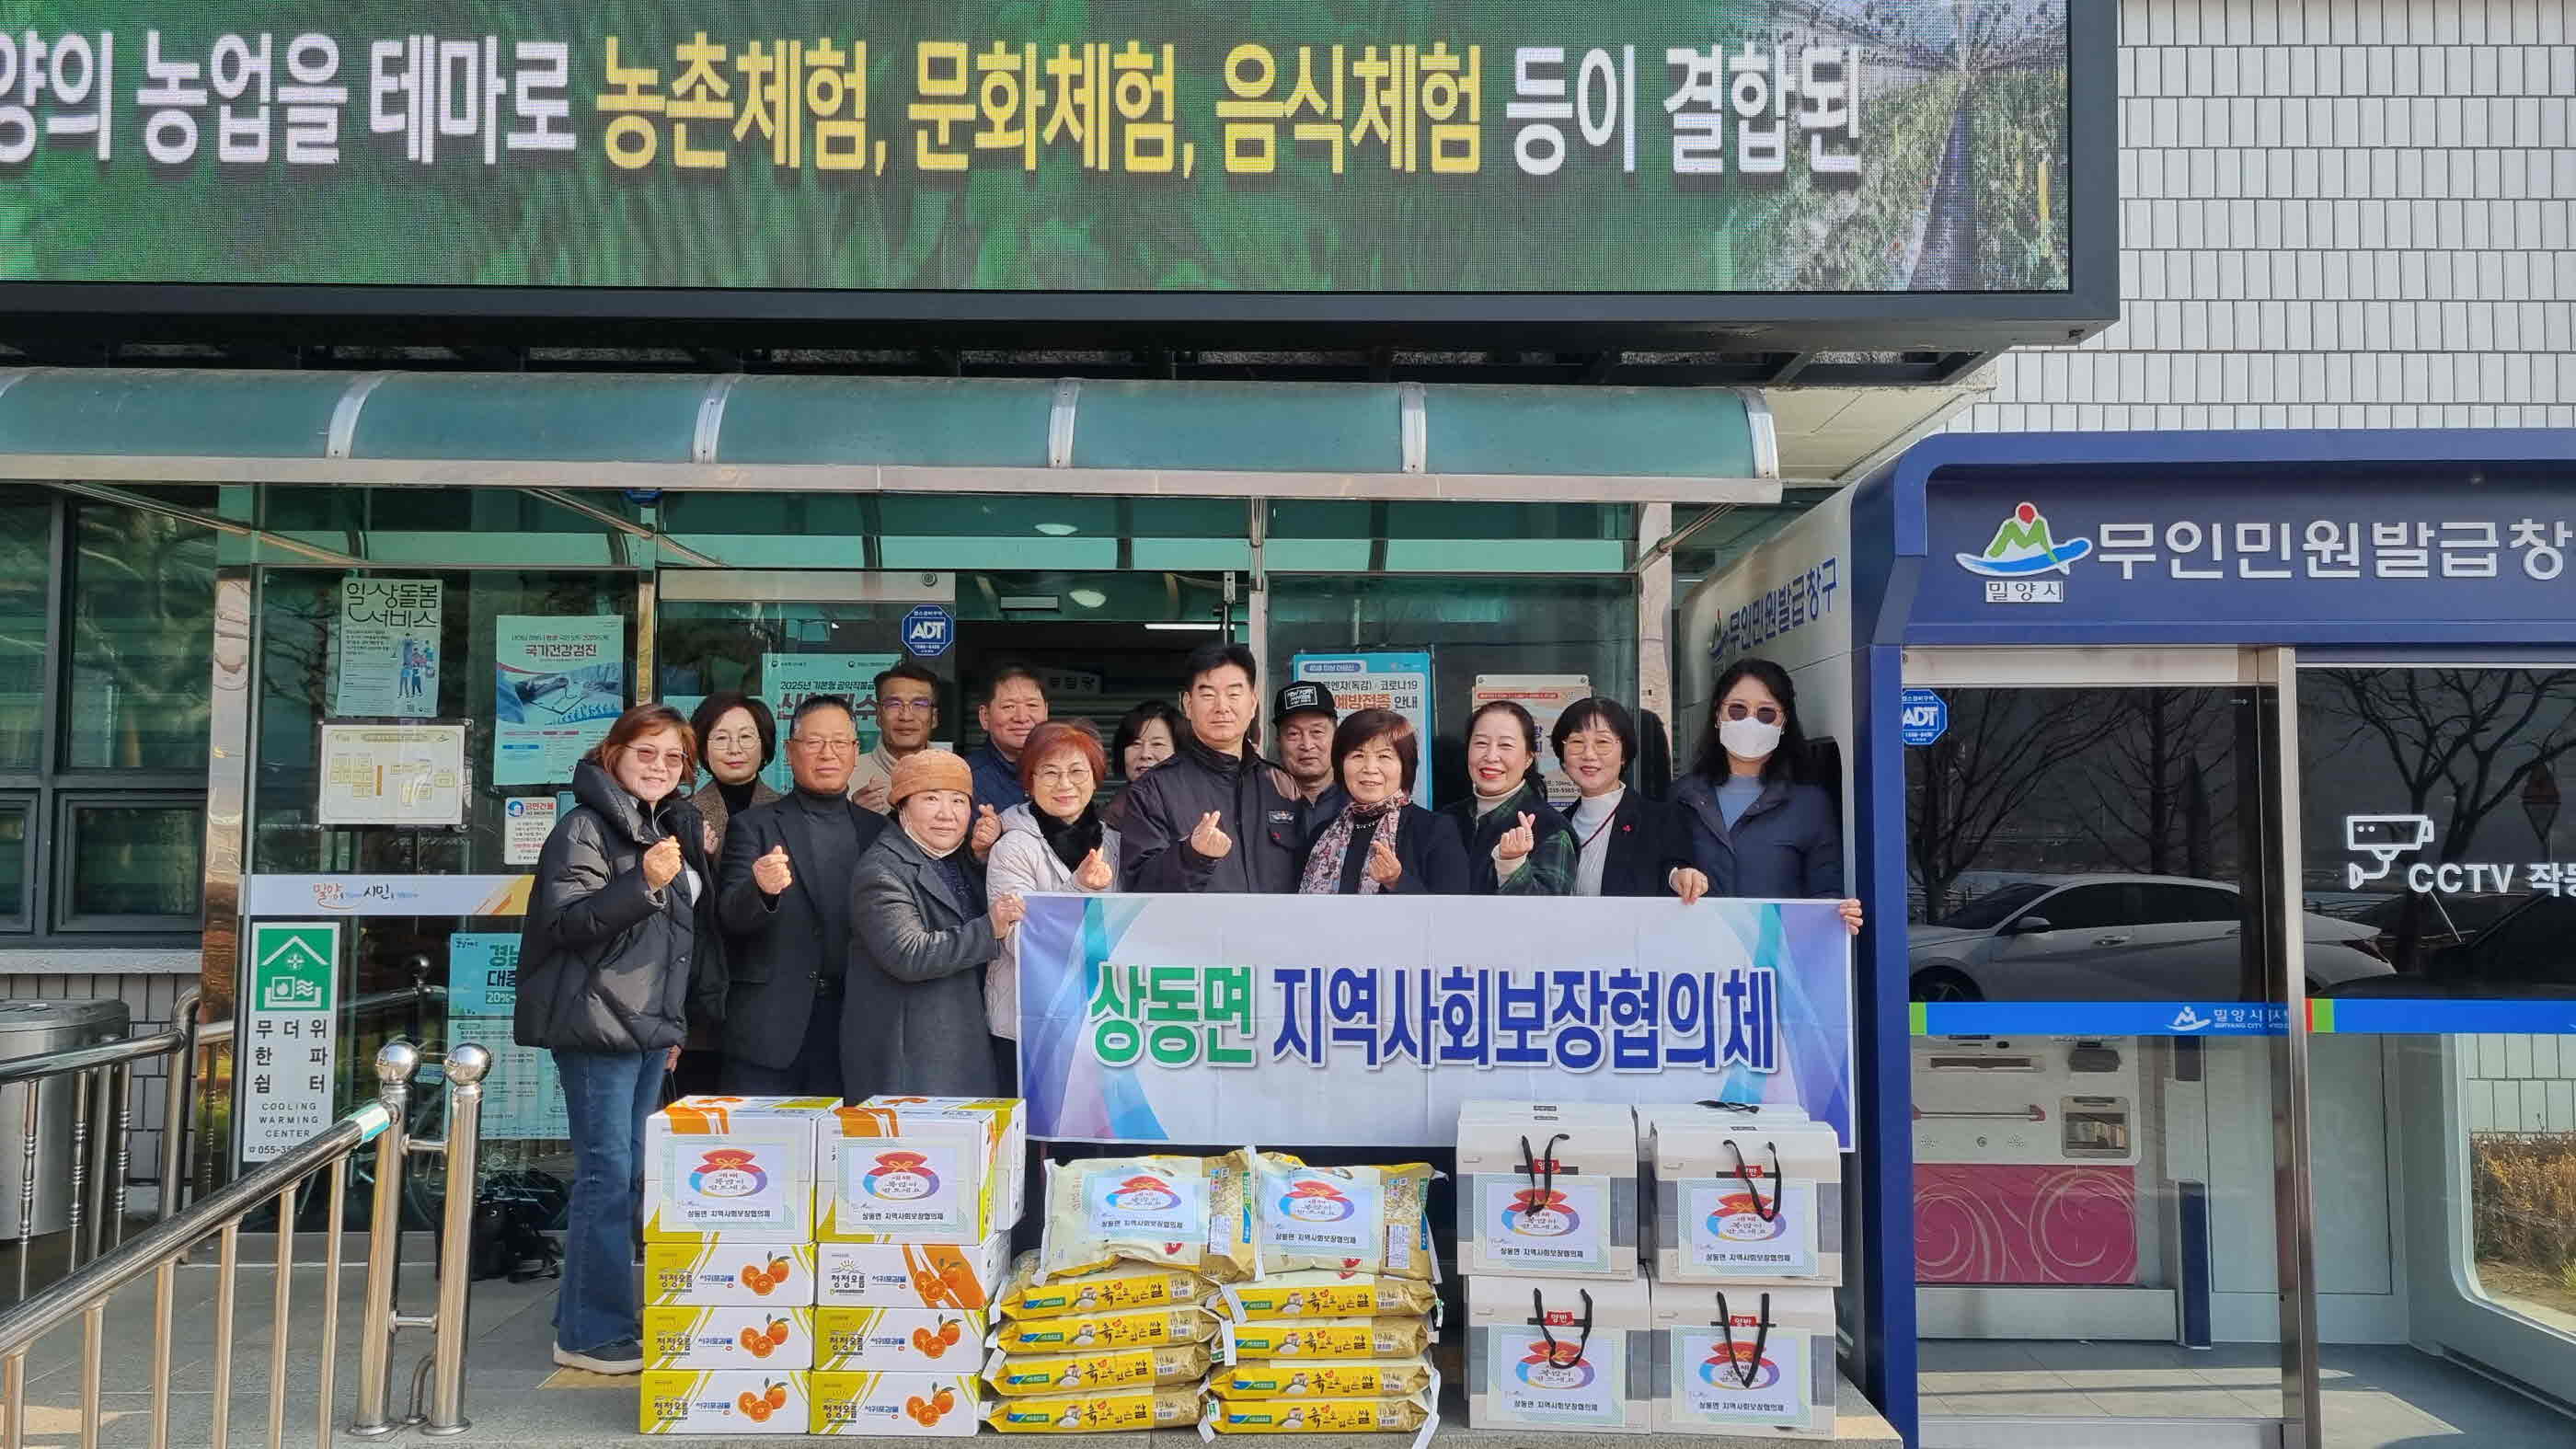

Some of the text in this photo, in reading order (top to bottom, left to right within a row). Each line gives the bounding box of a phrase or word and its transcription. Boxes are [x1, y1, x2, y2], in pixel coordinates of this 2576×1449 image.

[137, 30, 348, 165] 농업을
[371, 35, 576, 165] 테마로
[596, 32, 886, 177] 농촌체험,
[908, 40, 1194, 178] 문화체험,
[1216, 42, 1481, 174] 음식체험
[1506, 45, 1635, 175] 등이
[1664, 41, 1862, 174] 결합된
[347, 582, 438, 609] 일상돌봄
[1988, 581, 2063, 602] 밀양시
[1730, 557, 1837, 656] 무인민원발급창구
[361, 609, 439, 627] 서비스
[911, 621, 945, 639] ADT
[525, 643, 597, 657] 국가건강검진
[780, 681, 811, 691] 2025년
[1380, 680, 1418, 691] 코로나19
[1334, 693, 1419, 710] 예방접종 안내
[1903, 706, 1938, 727] ADT
[2408, 863, 2514, 893] CCTV
[1091, 966, 1776, 1073] 상동면 지역사회보장협의체
[2214, 1008, 2262, 1022] 밀양시
[256, 1019, 328, 1040] 무더위
[255, 1047, 328, 1066] 한파
[254, 1075, 325, 1094] 쉼터
[261, 1102, 317, 1111] COOLING
[259, 1115, 319, 1124] WARMING
[265, 1129, 311, 1138] CENTER
[659, 1274, 692, 1288] 청정오름
[831, 1274, 865, 1289] 청정오름
[1150, 1282, 1164, 1299] 쌀
[1356, 1293, 1370, 1308] 쌀
[1149, 1320, 1162, 1336] 쌀
[656, 1337, 691, 1351] 청정오름
[829, 1337, 864, 1351] 청정오름
[1353, 1334, 1366, 1350] 쌀
[1134, 1360, 1148, 1376] 쌀
[1362, 1375, 1374, 1390] 쌀
[654, 1402, 689, 1416] 청정오름
[822, 1404, 857, 1419] 청정오름
[1134, 1404, 1147, 1420] 쌀
[1358, 1409, 1370, 1425] 쌀
